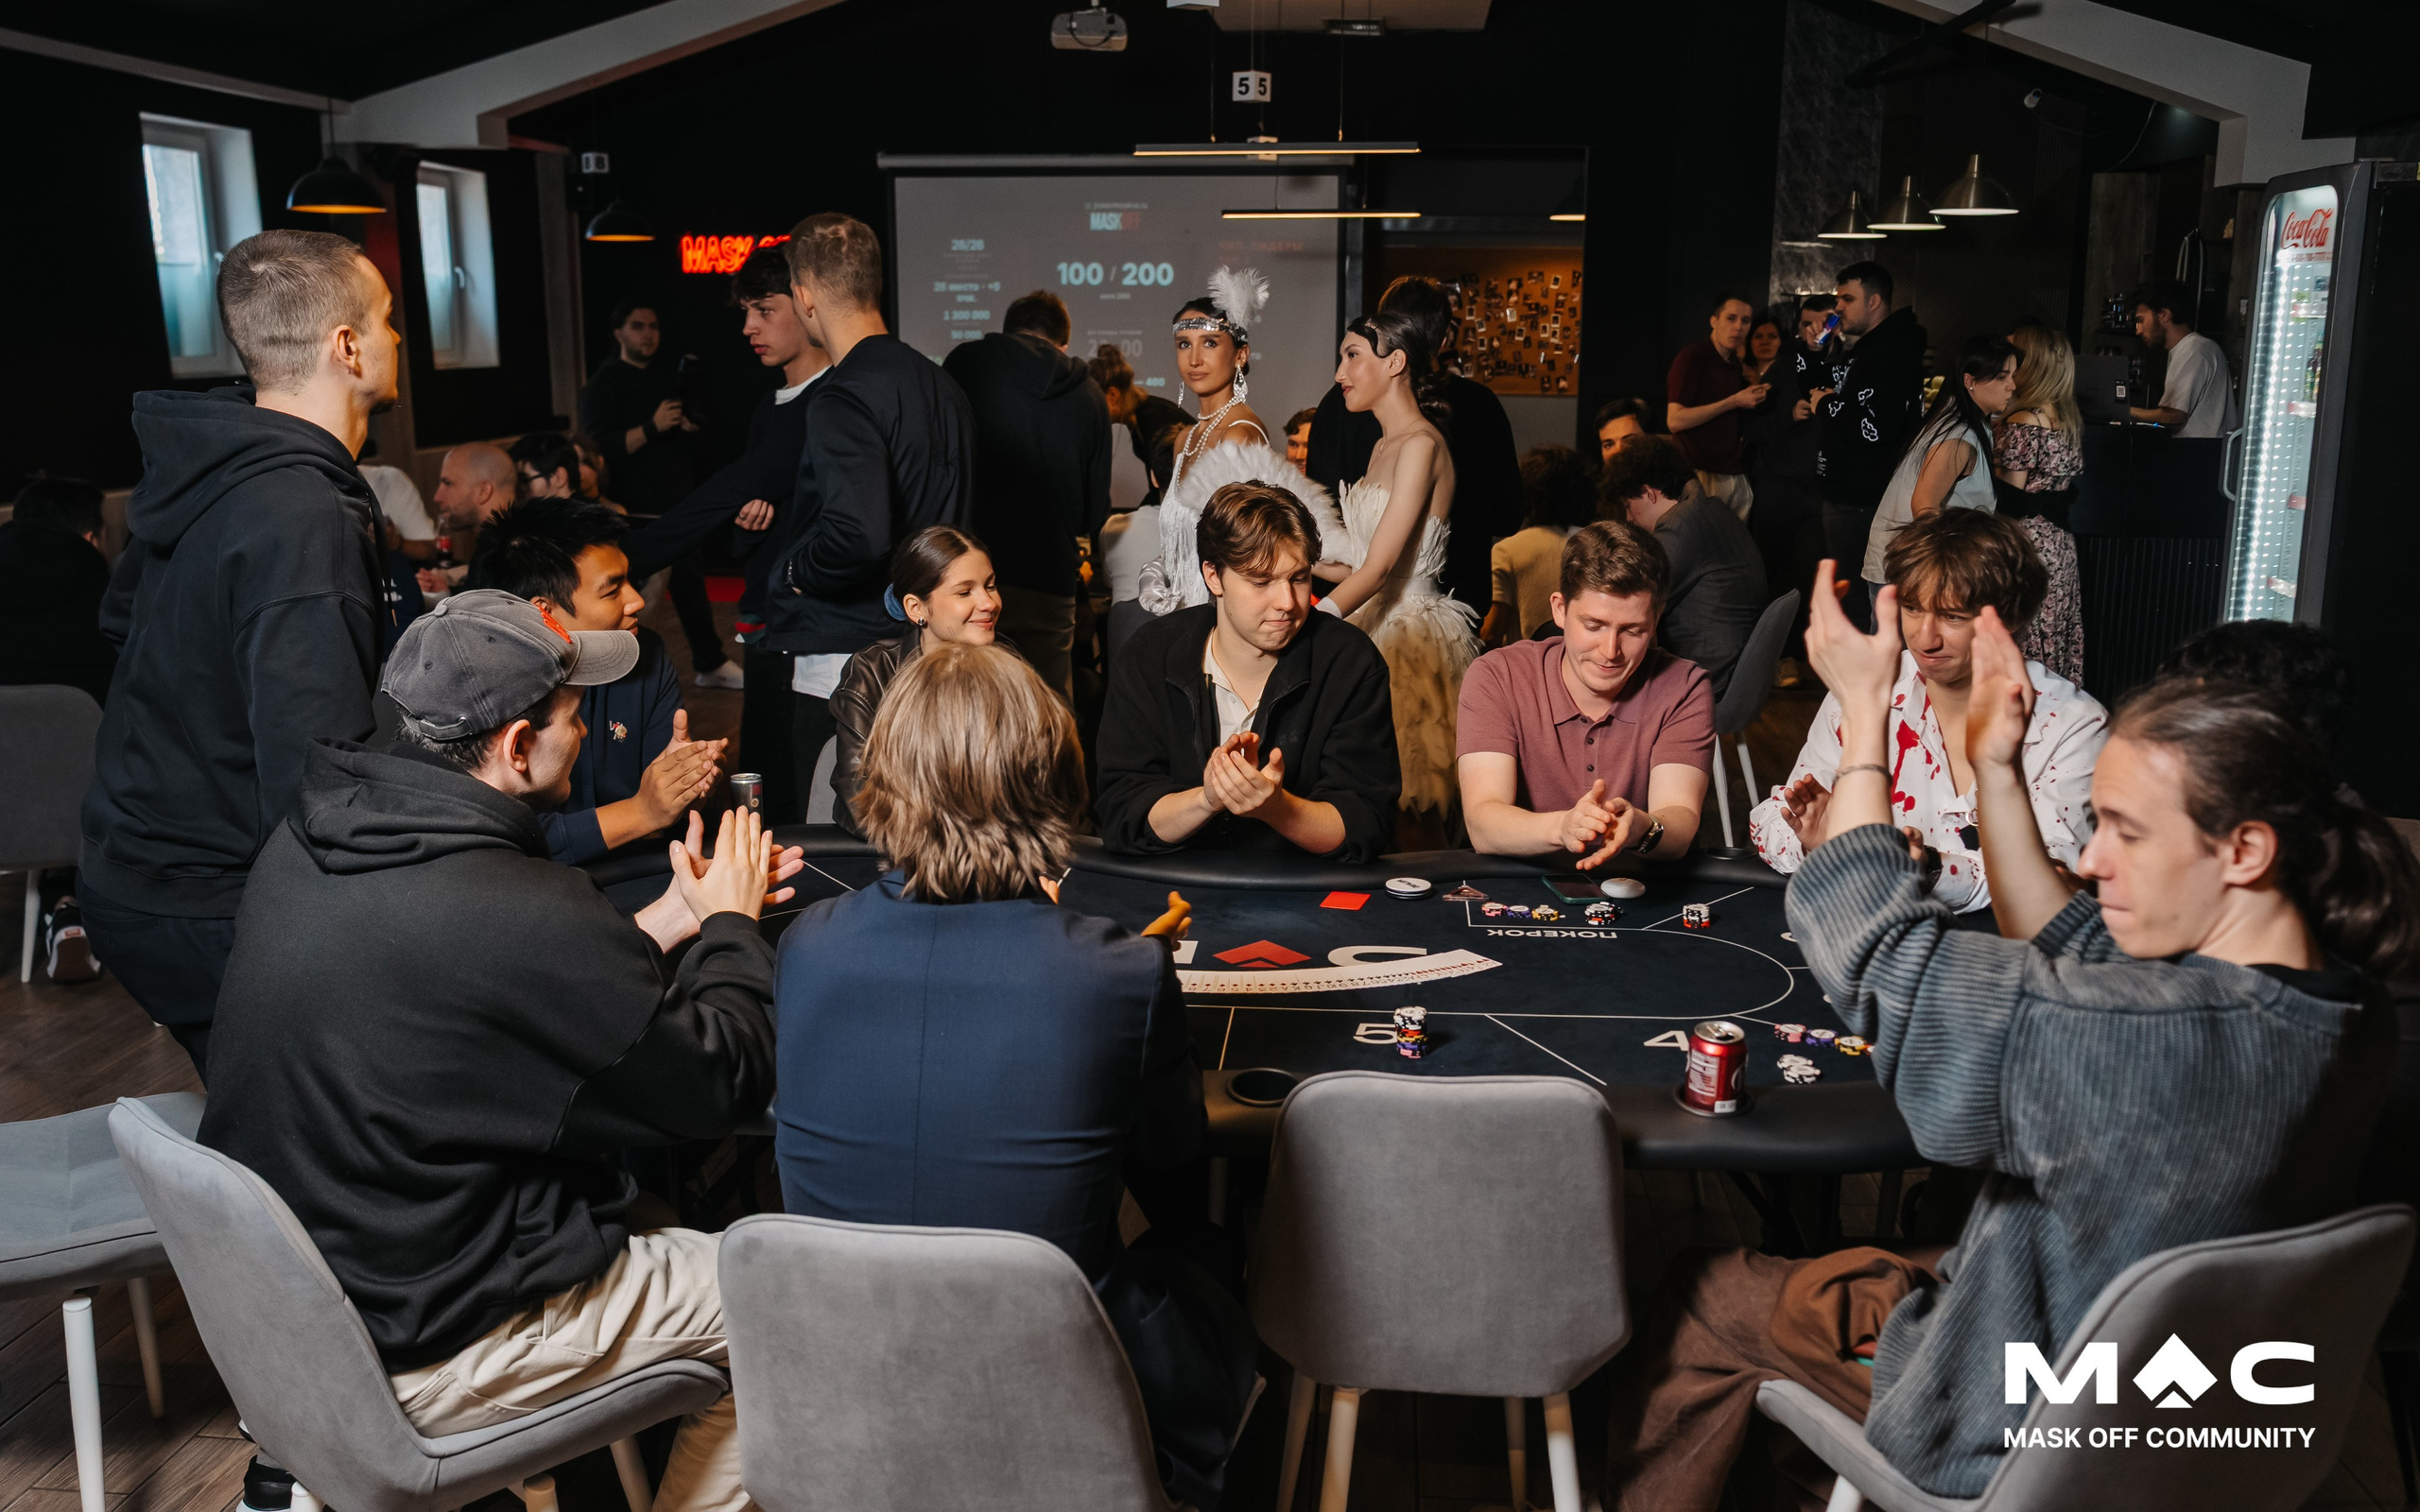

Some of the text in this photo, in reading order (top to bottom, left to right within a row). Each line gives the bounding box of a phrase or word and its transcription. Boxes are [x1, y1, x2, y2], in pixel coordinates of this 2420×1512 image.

[1237, 77, 1250, 95] 5
[1257, 77, 1267, 95] 5
[1056, 262, 1104, 286] 100
[1121, 262, 1174, 286] 200
[1486, 929, 1617, 938] ПОКЕРОК
[1353, 1022, 1399, 1044] 5
[1643, 1030, 1690, 1051] 4
